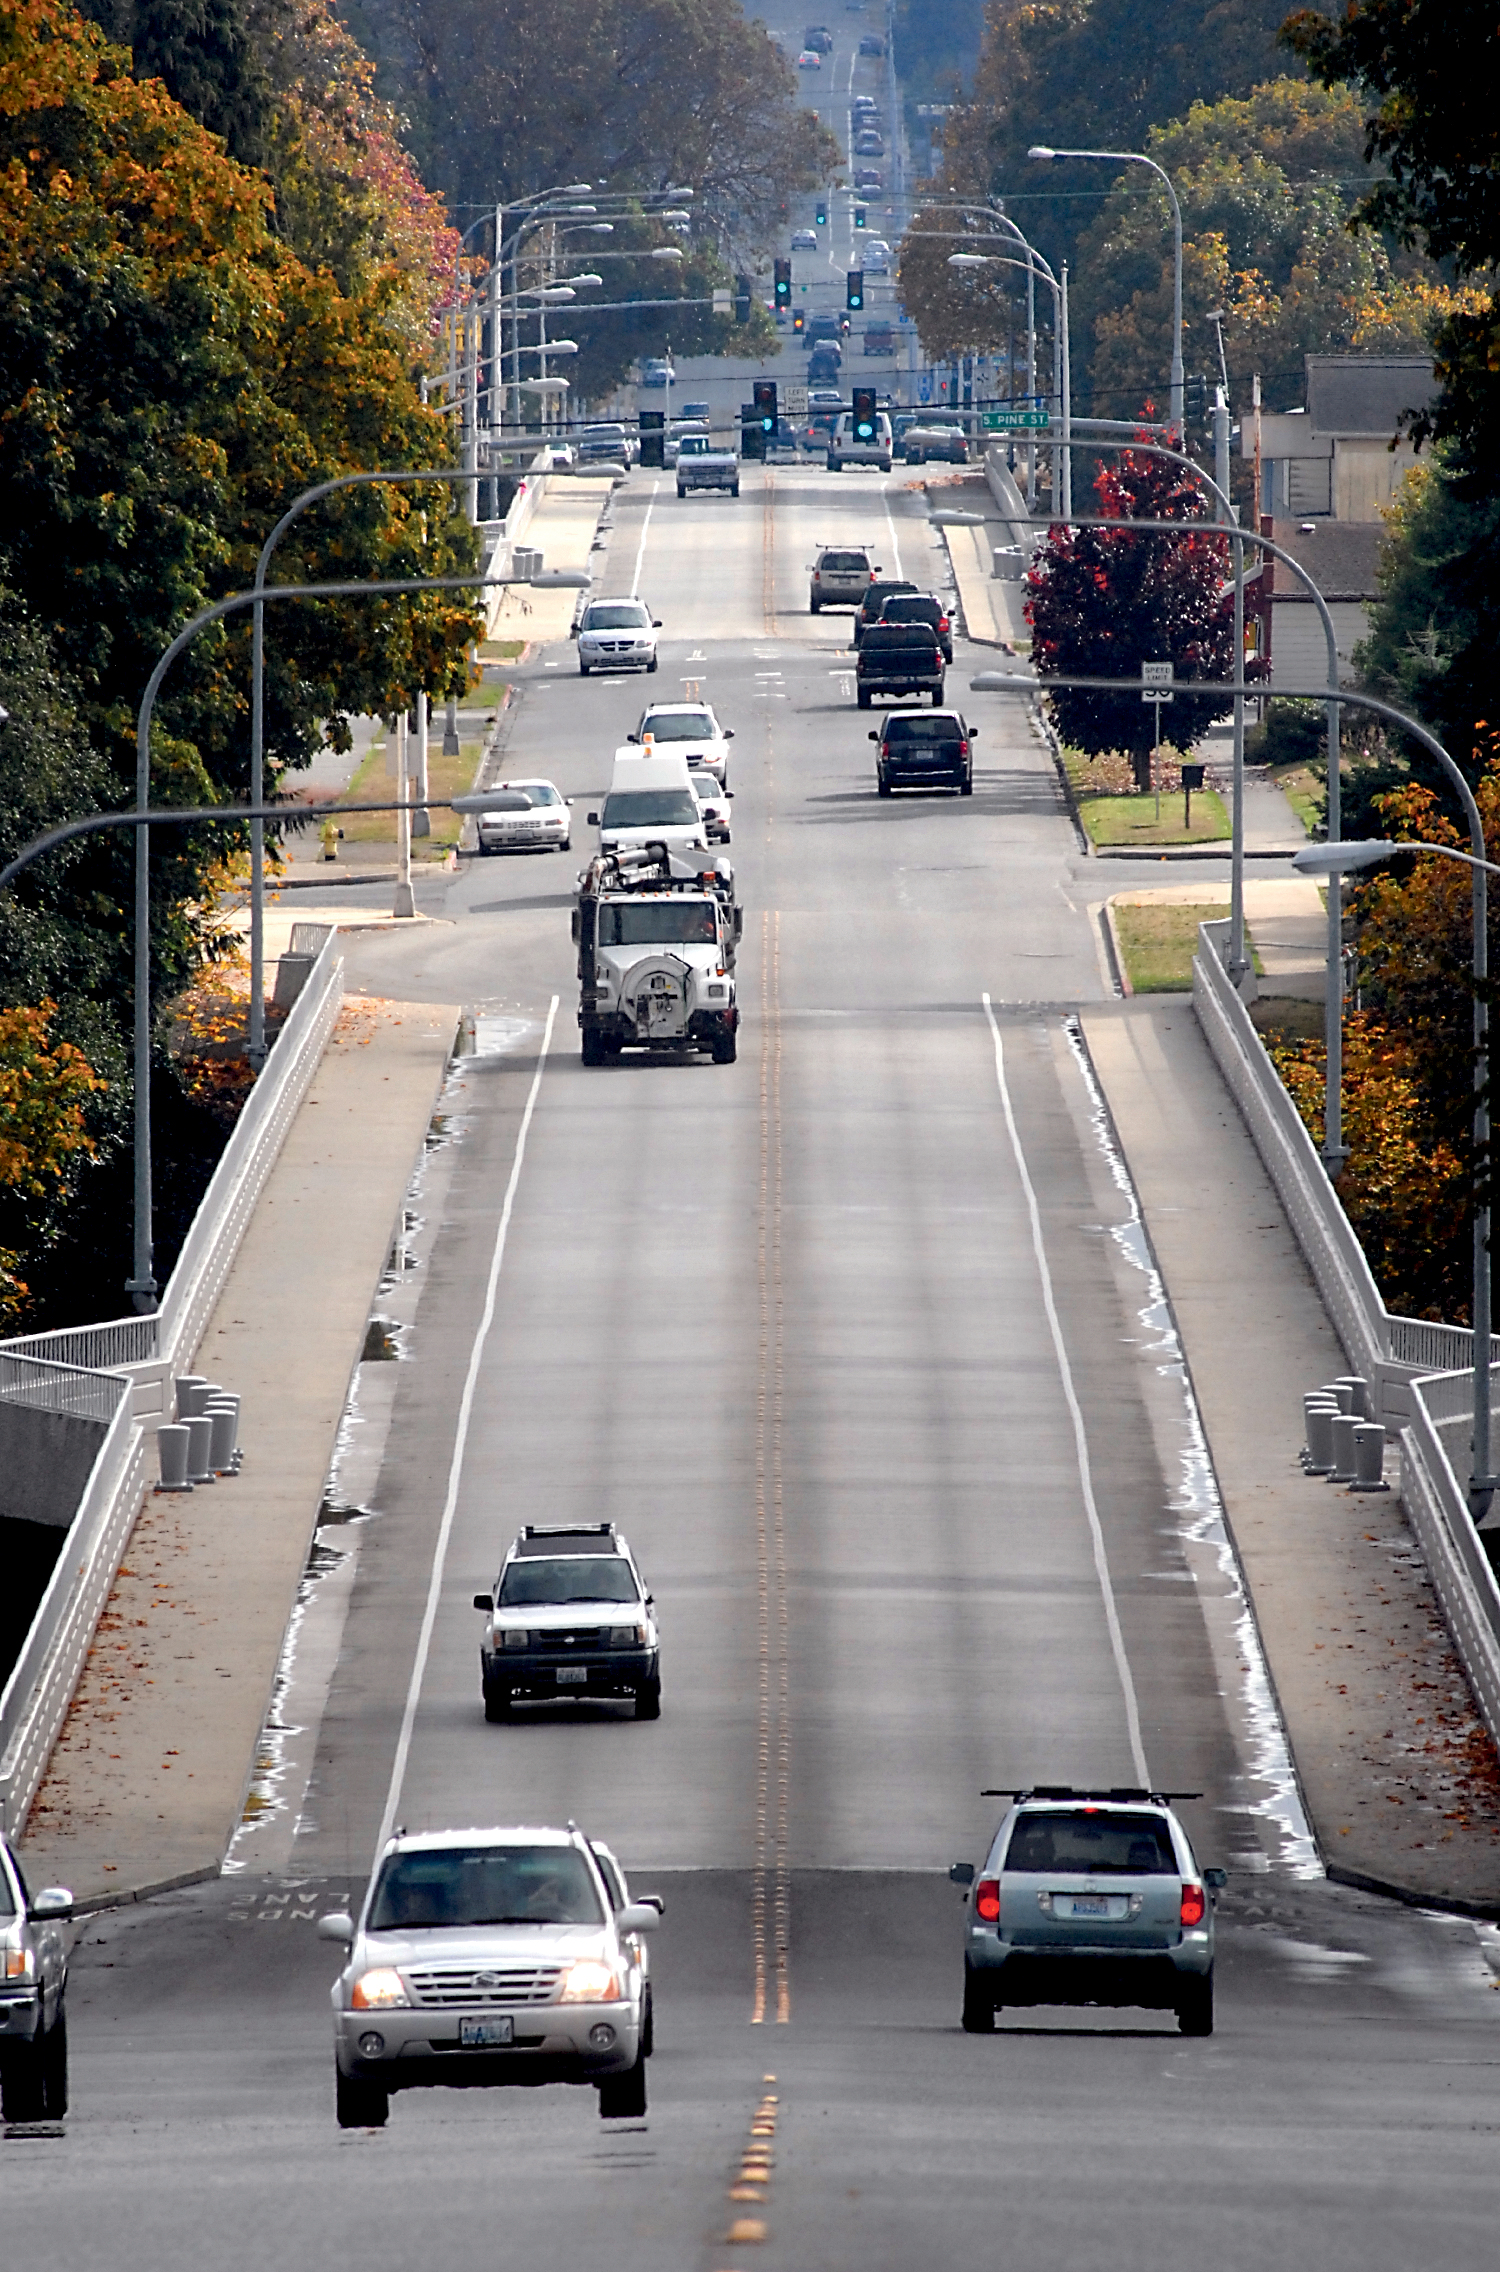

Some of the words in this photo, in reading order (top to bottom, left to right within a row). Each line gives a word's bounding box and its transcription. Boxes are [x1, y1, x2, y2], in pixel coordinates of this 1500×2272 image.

[983, 415, 993, 425] S.
[997, 415, 1026, 425] PINE
[1030, 414, 1048, 425] ST.
[231, 1893, 350, 1905] LANE
